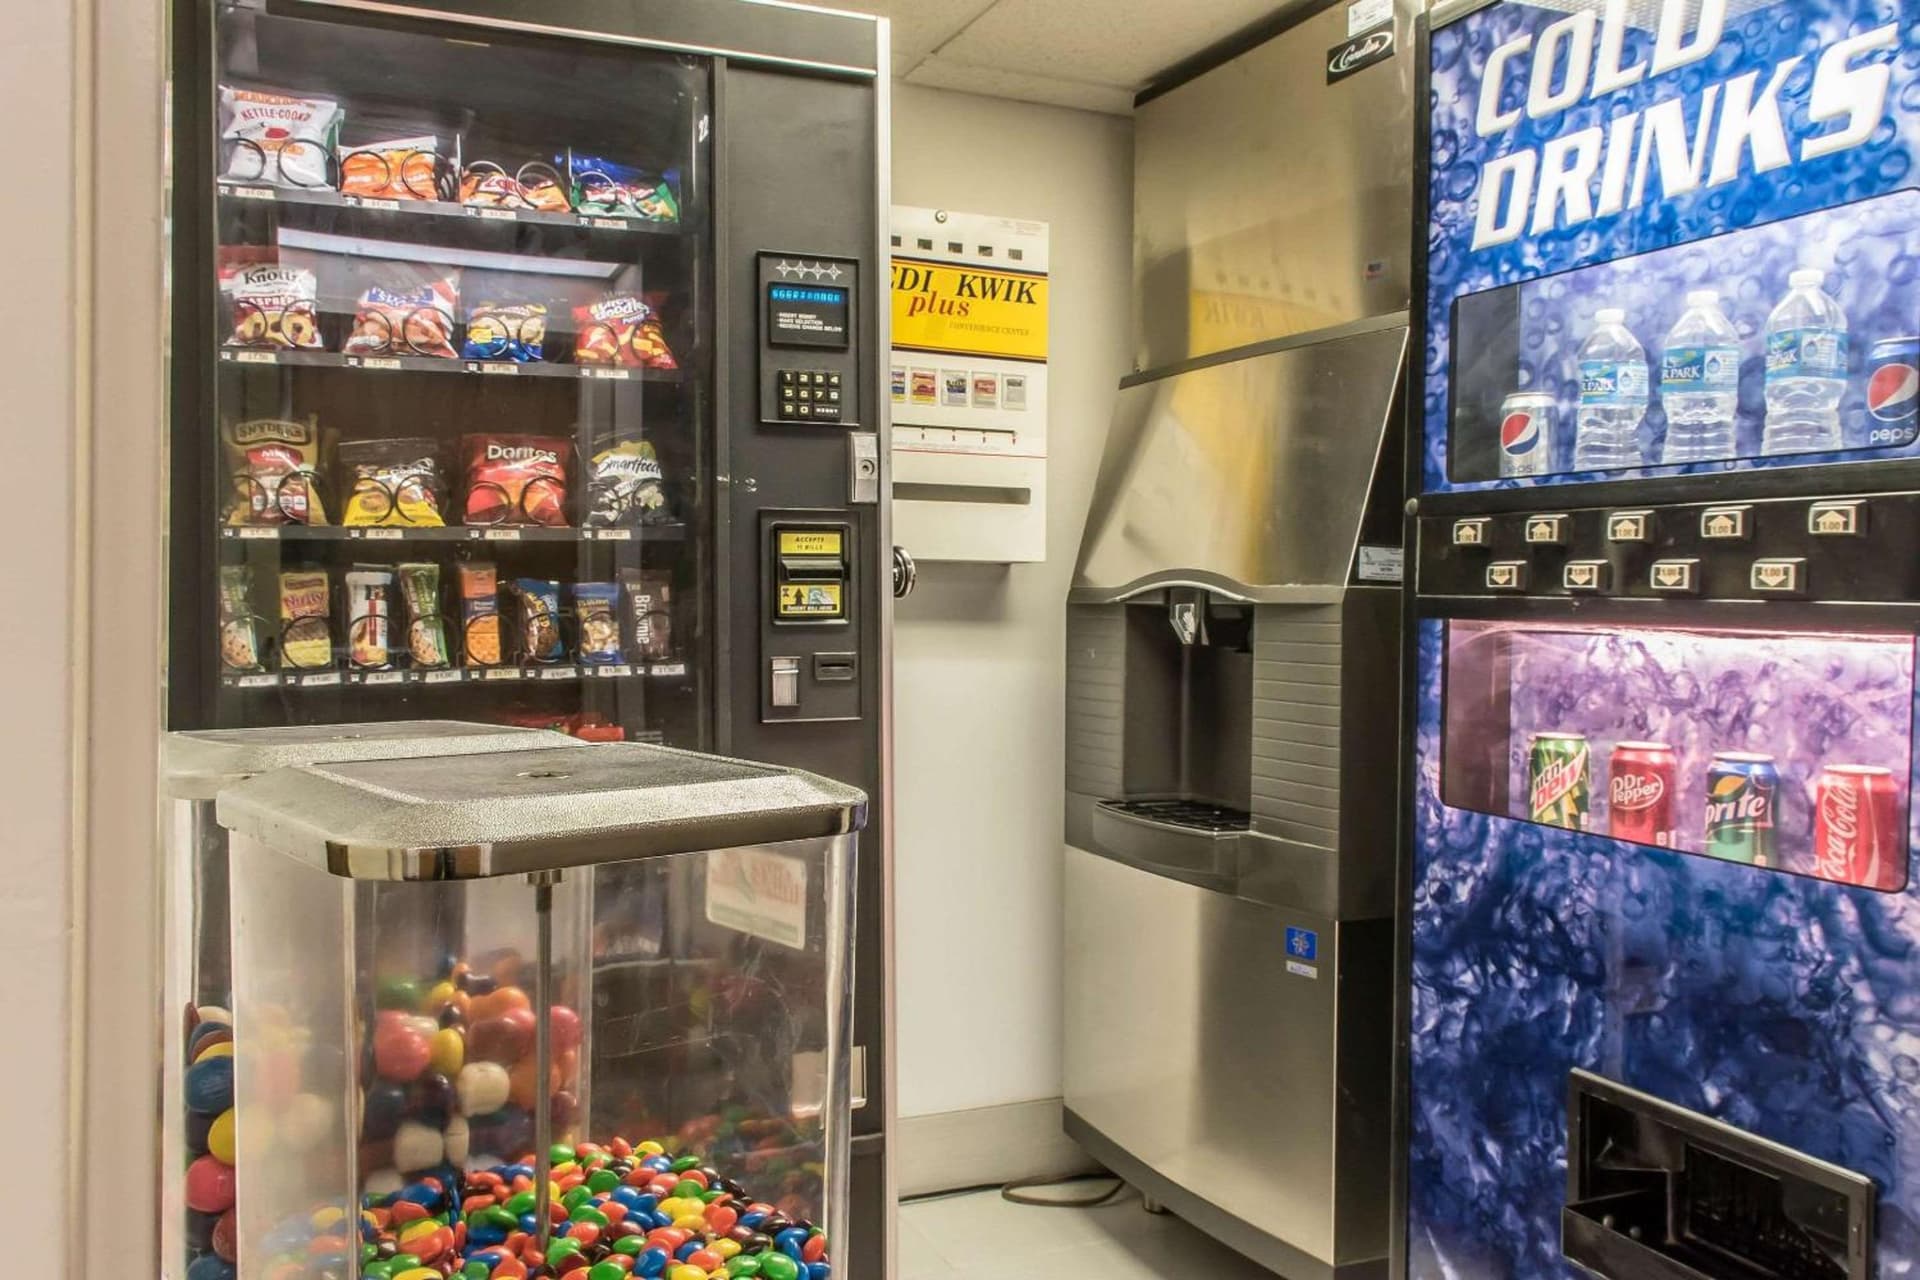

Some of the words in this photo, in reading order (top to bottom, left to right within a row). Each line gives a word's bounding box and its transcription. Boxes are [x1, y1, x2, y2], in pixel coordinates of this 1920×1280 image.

[1475, 0, 1728, 137] COLD
[1471, 22, 1899, 252] DRINKS
[955, 274, 1038, 305] KWIK
[907, 291, 970, 317] plus
[800, 374, 808, 382] 2
[816, 375, 824, 383] 3
[830, 376, 839, 384] 4
[785, 389, 793, 397] 5
[800, 390, 808, 398] 6
[815, 391, 823, 399] 7
[830, 391, 838, 400] 8
[785, 405, 793, 413] 9
[800, 406, 808, 414] 0
[1870, 428, 1915, 446] peps
[487, 445, 558, 464] Doritos
[634, 594, 652, 645] Brownie
[1612, 778, 1661, 806] Pepper
[1624, 775, 1646, 796] Dr
[1705, 788, 1766, 832] prite
